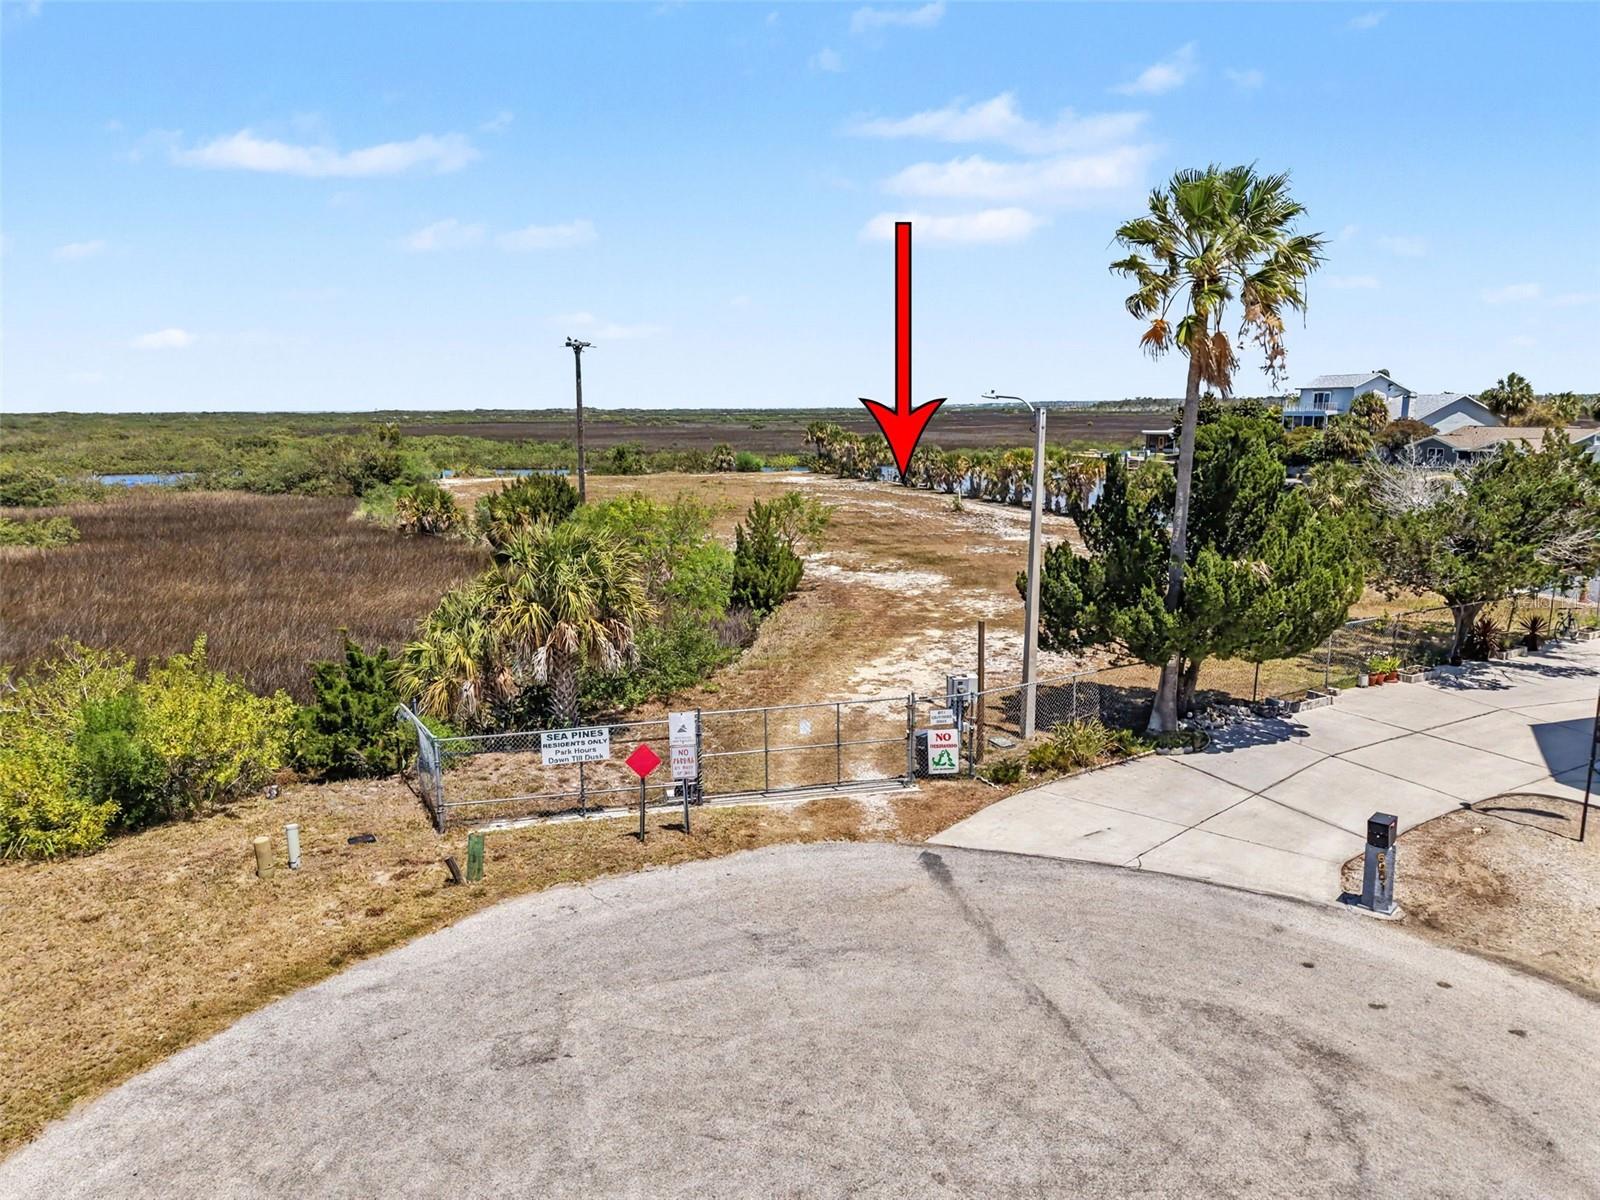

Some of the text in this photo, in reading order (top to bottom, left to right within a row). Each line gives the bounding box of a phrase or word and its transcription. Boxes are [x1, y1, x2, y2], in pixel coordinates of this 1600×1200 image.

[546, 730, 604, 741] SEA PINES
[935, 733, 952, 741] NO
[543, 740, 586, 748] RESIDENTS
[584, 753, 604, 761] Dusk
